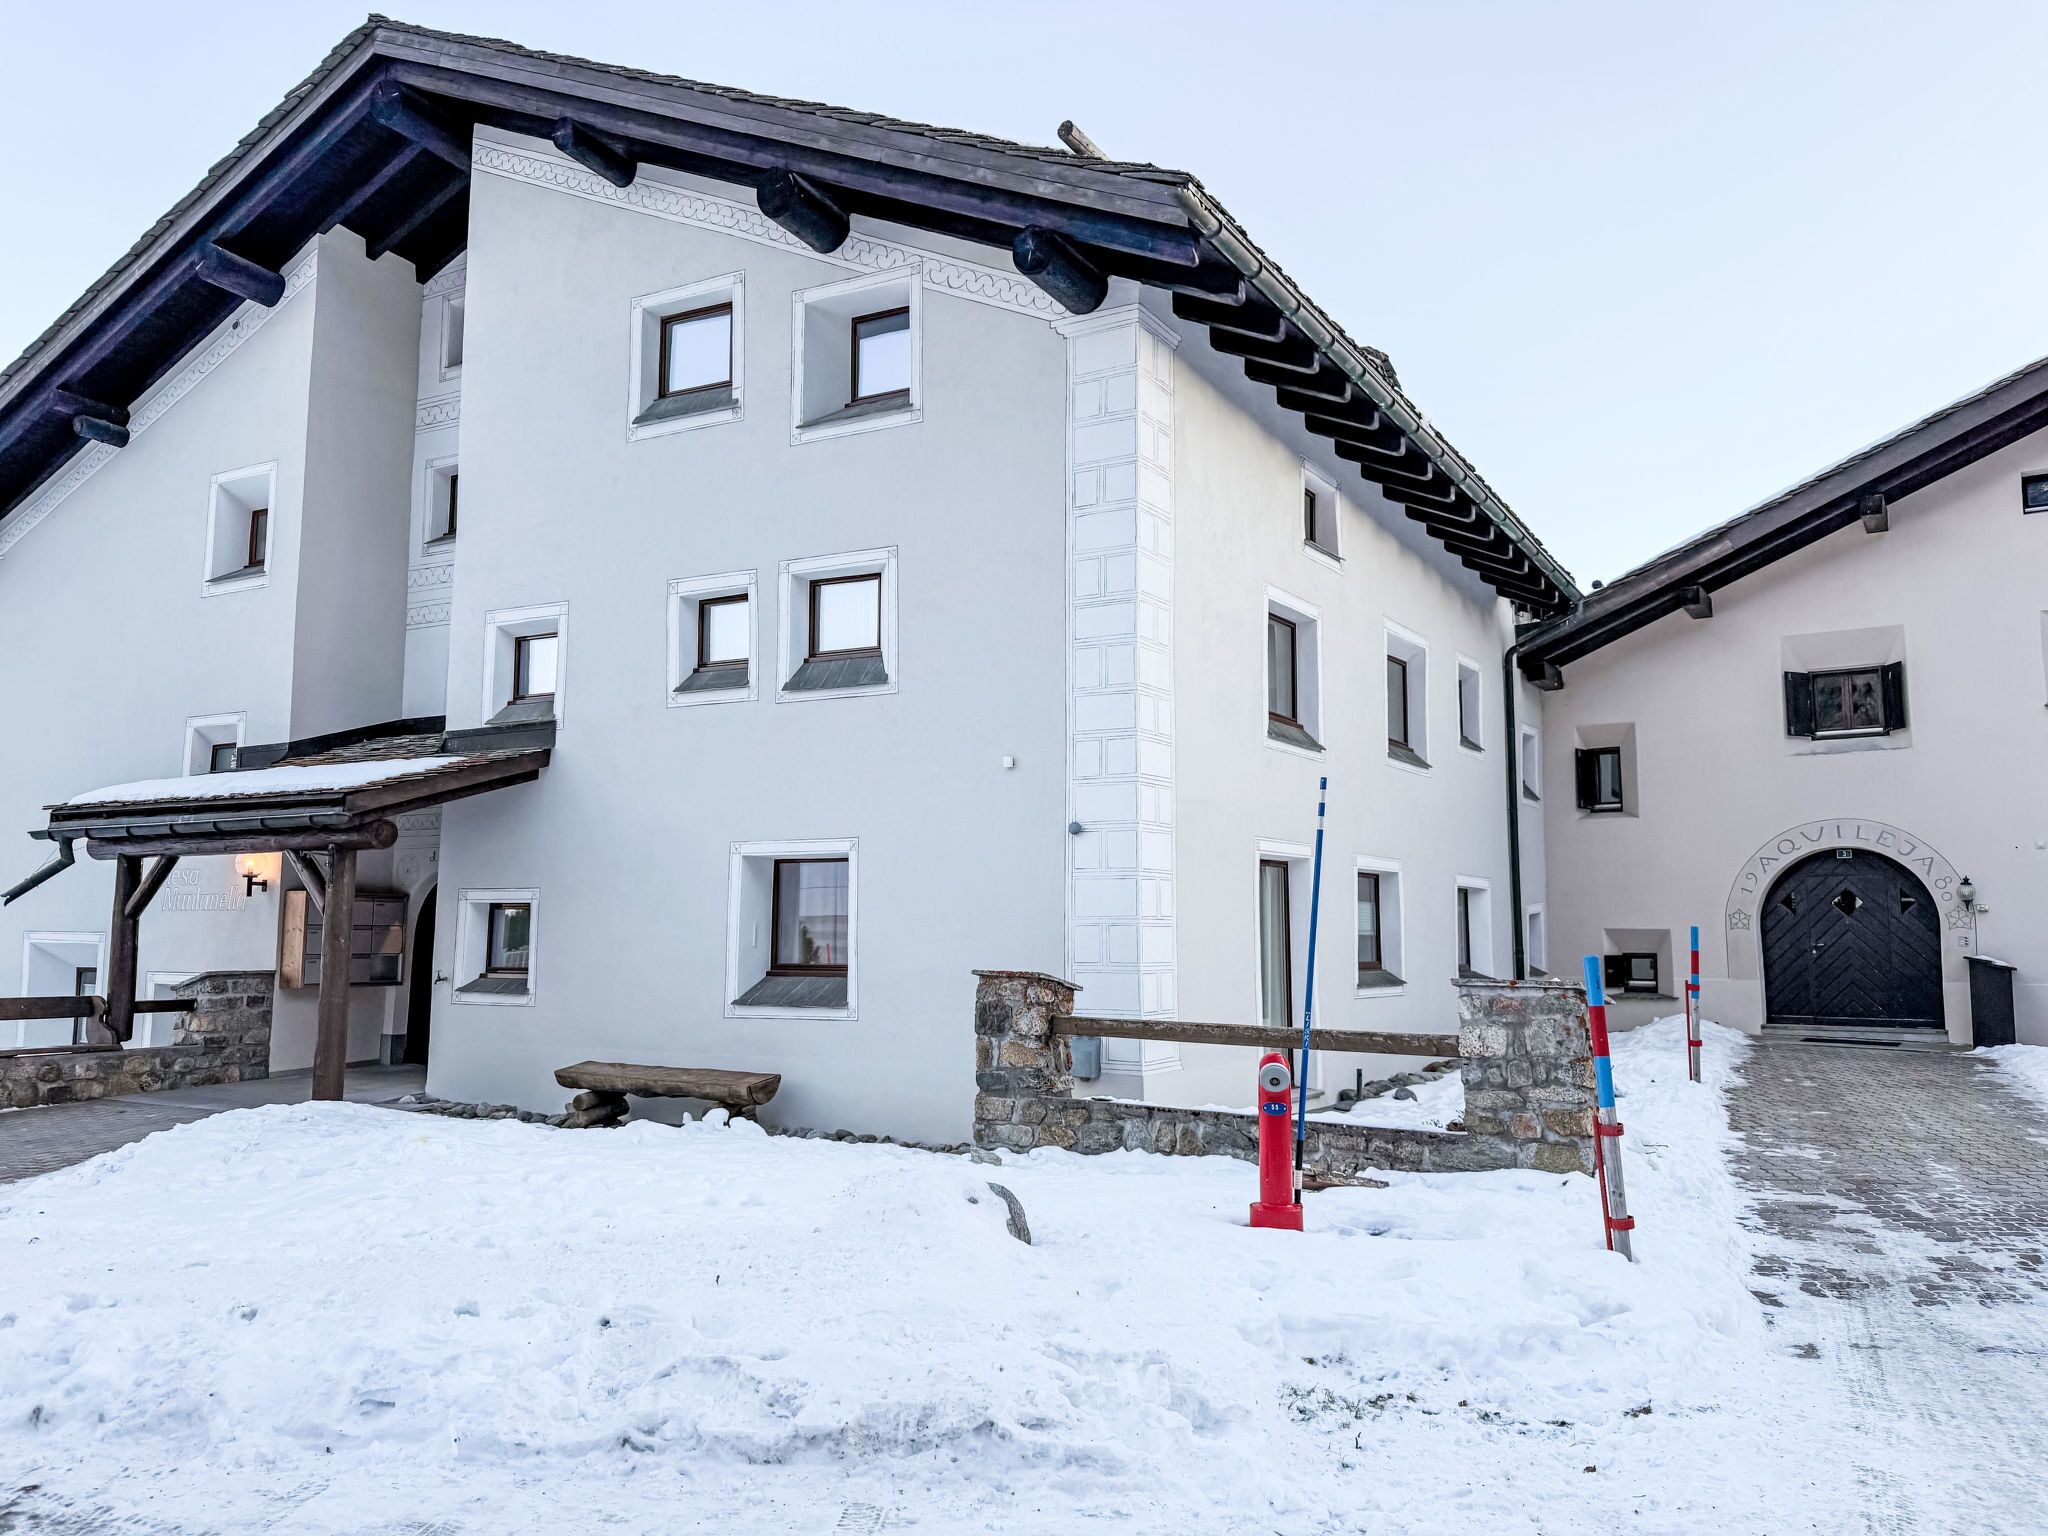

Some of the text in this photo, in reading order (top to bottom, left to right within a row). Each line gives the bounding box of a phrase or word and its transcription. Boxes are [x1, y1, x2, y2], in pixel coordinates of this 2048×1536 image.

[1741, 824, 1953, 901] 19 AQUILEJA 80
